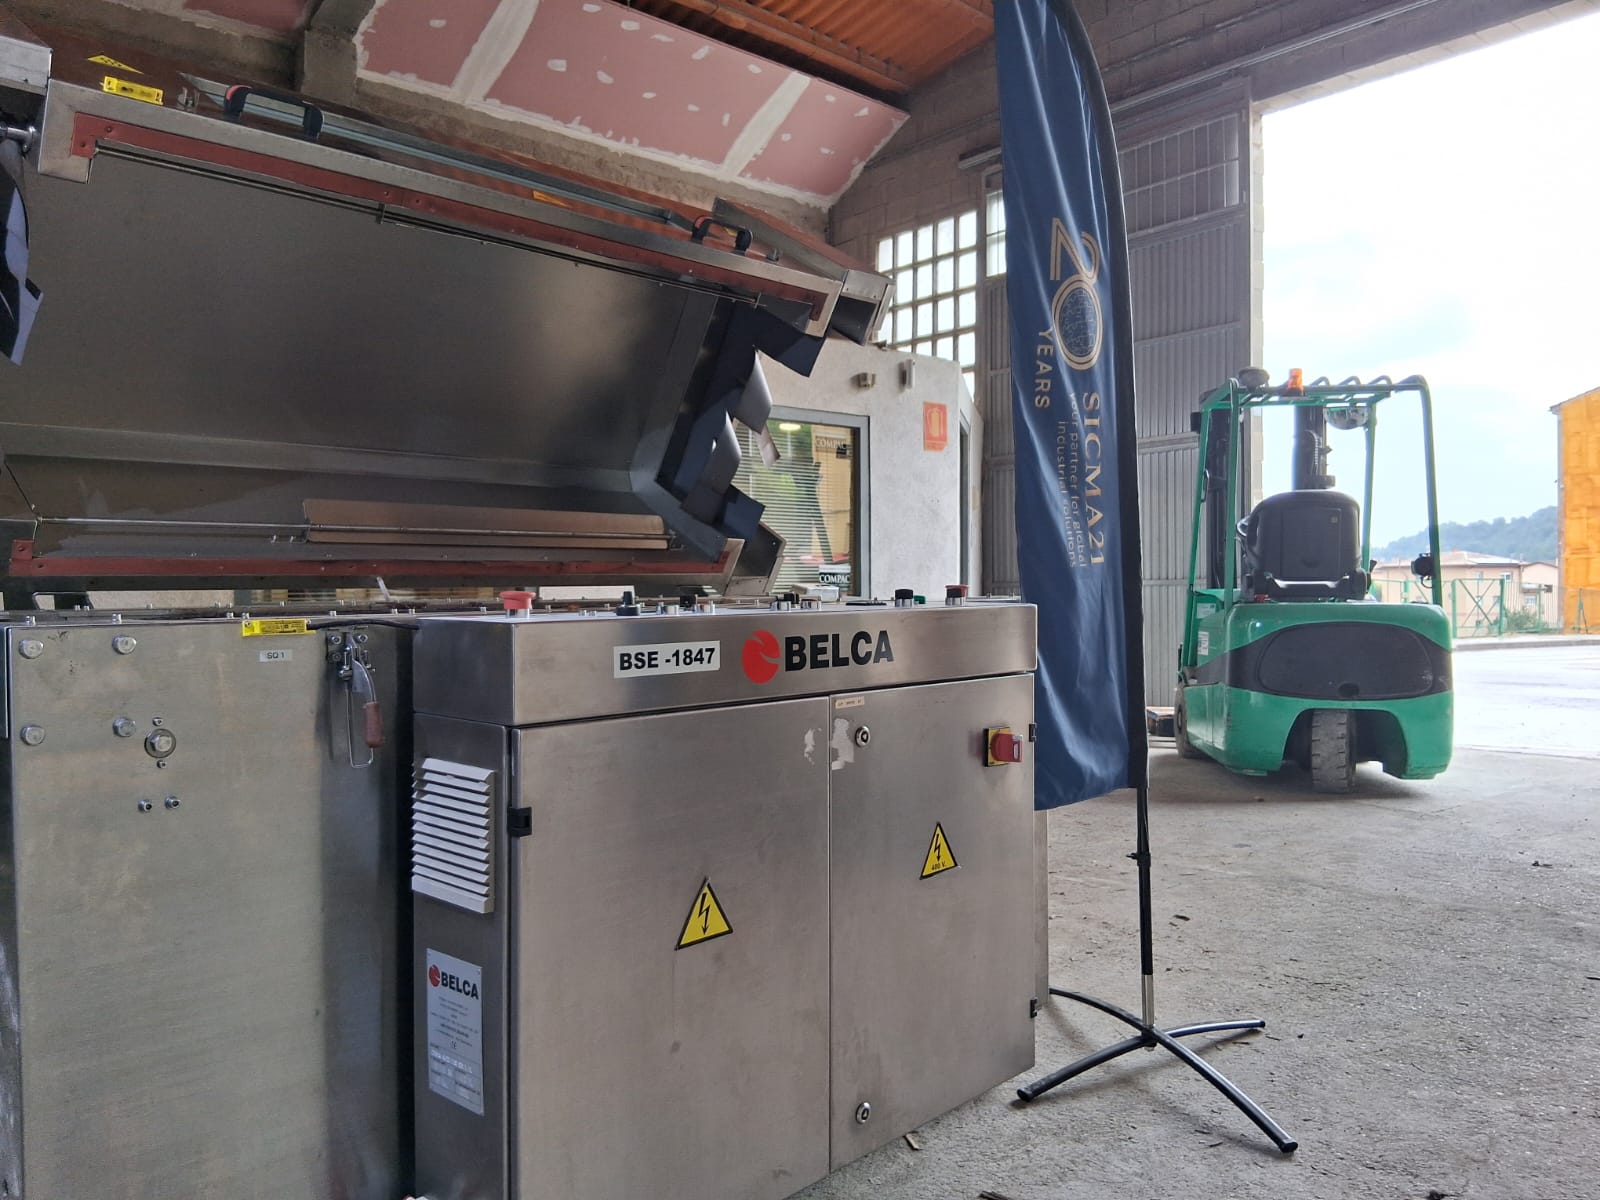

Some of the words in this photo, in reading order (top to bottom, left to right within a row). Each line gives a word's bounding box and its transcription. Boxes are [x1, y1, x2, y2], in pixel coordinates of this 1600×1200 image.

[1050, 217, 1103, 370] 20
[1035, 326, 1054, 408] YEARS
[1069, 392, 1079, 427] your
[1056, 420, 1069, 494] industrial
[1069, 432, 1079, 490] partner
[1082, 392, 1104, 564] SICMA21
[1071, 495, 1080, 516] for
[1072, 521, 1087, 567] global
[819, 574, 850, 583] COMPAC
[266, 651, 279, 659] SQ
[619, 650, 659, 671] BSE
[665, 647, 715, 667] -1847
[784, 630, 894, 672] BELCA
[441, 971, 479, 1000] BELCA
